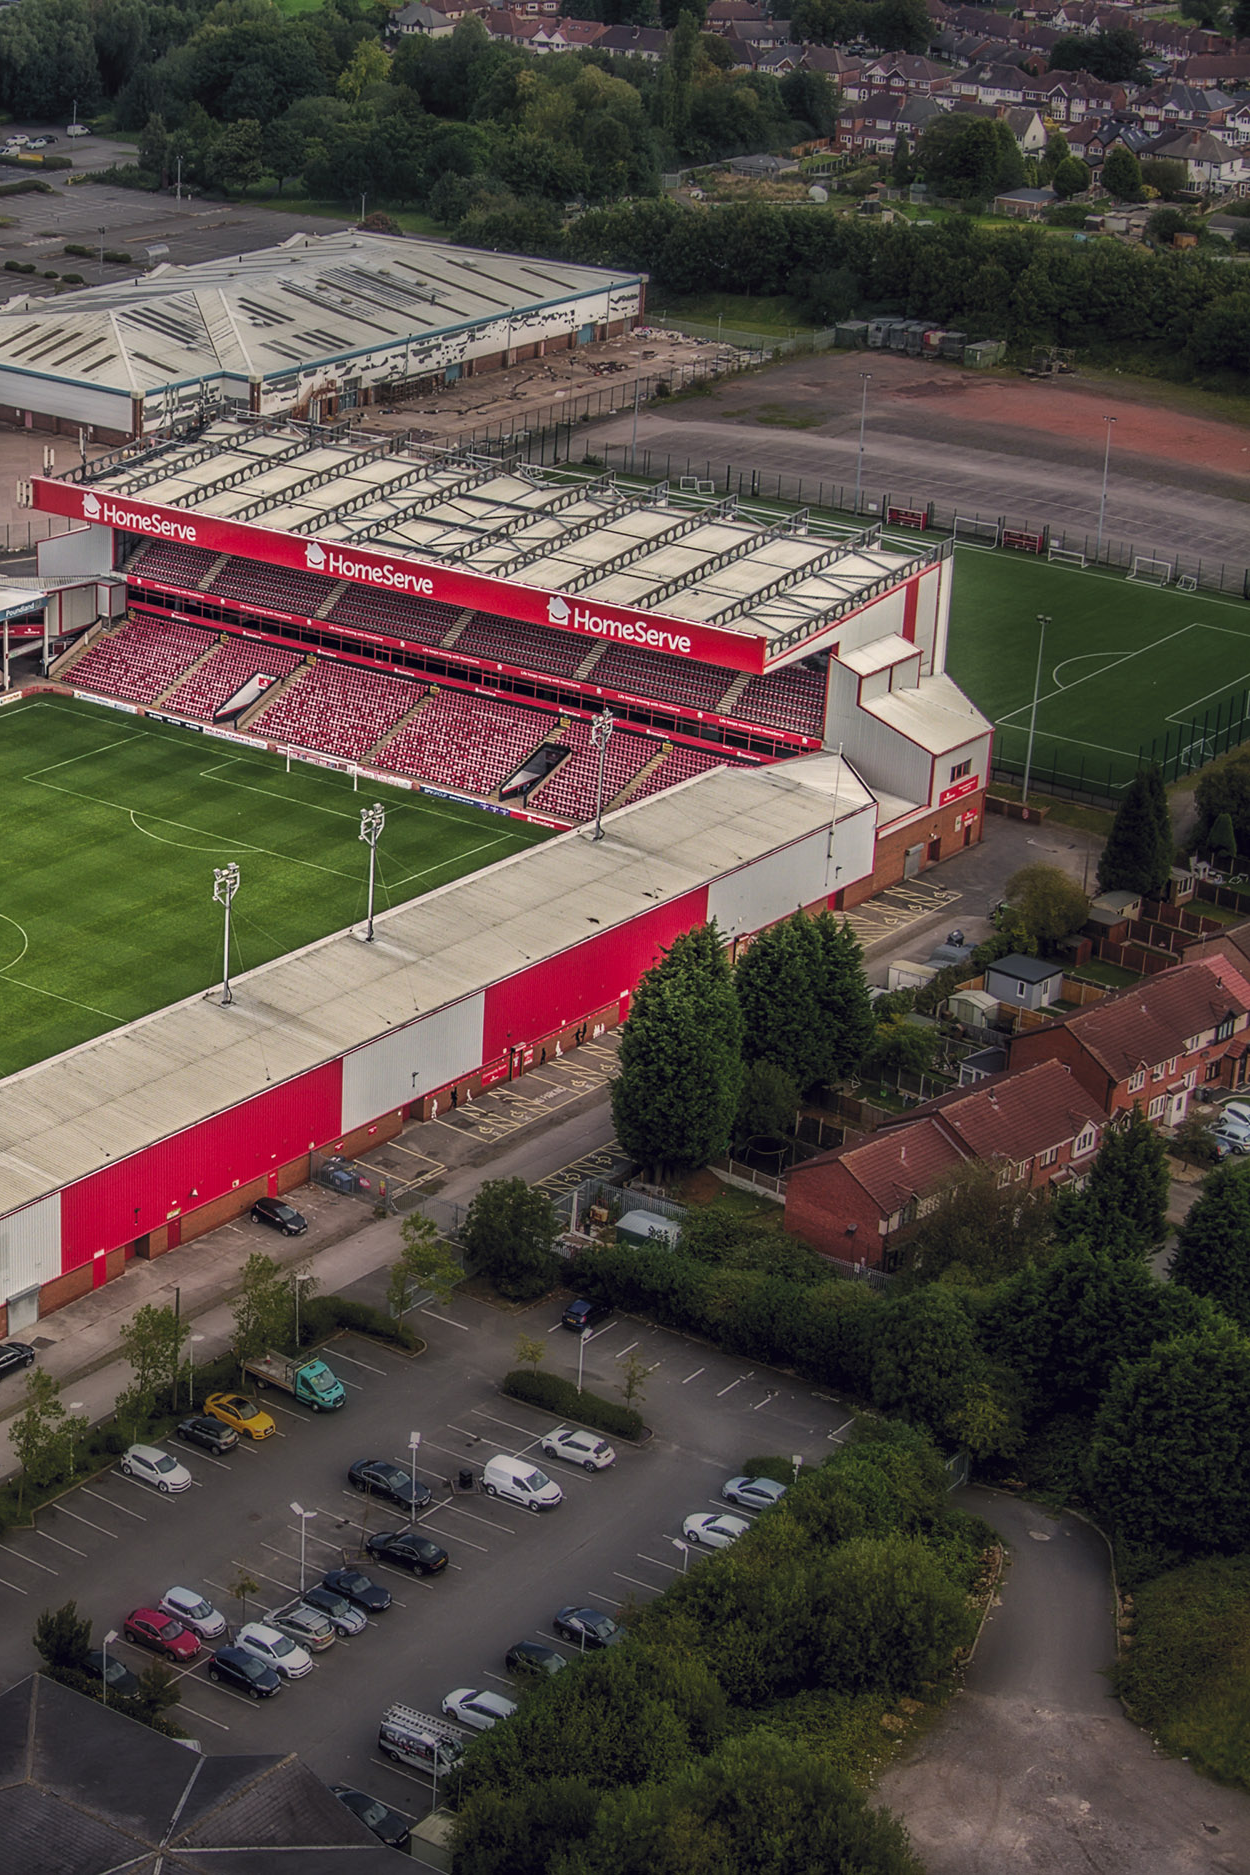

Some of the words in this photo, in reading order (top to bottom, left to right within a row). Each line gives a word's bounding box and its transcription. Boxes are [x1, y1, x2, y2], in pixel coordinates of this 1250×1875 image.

[104, 502, 197, 541] HomeServe
[330, 552, 433, 594] HomeServe
[6, 602, 35, 617] Poundland
[574, 608, 691, 653] HomeServe
